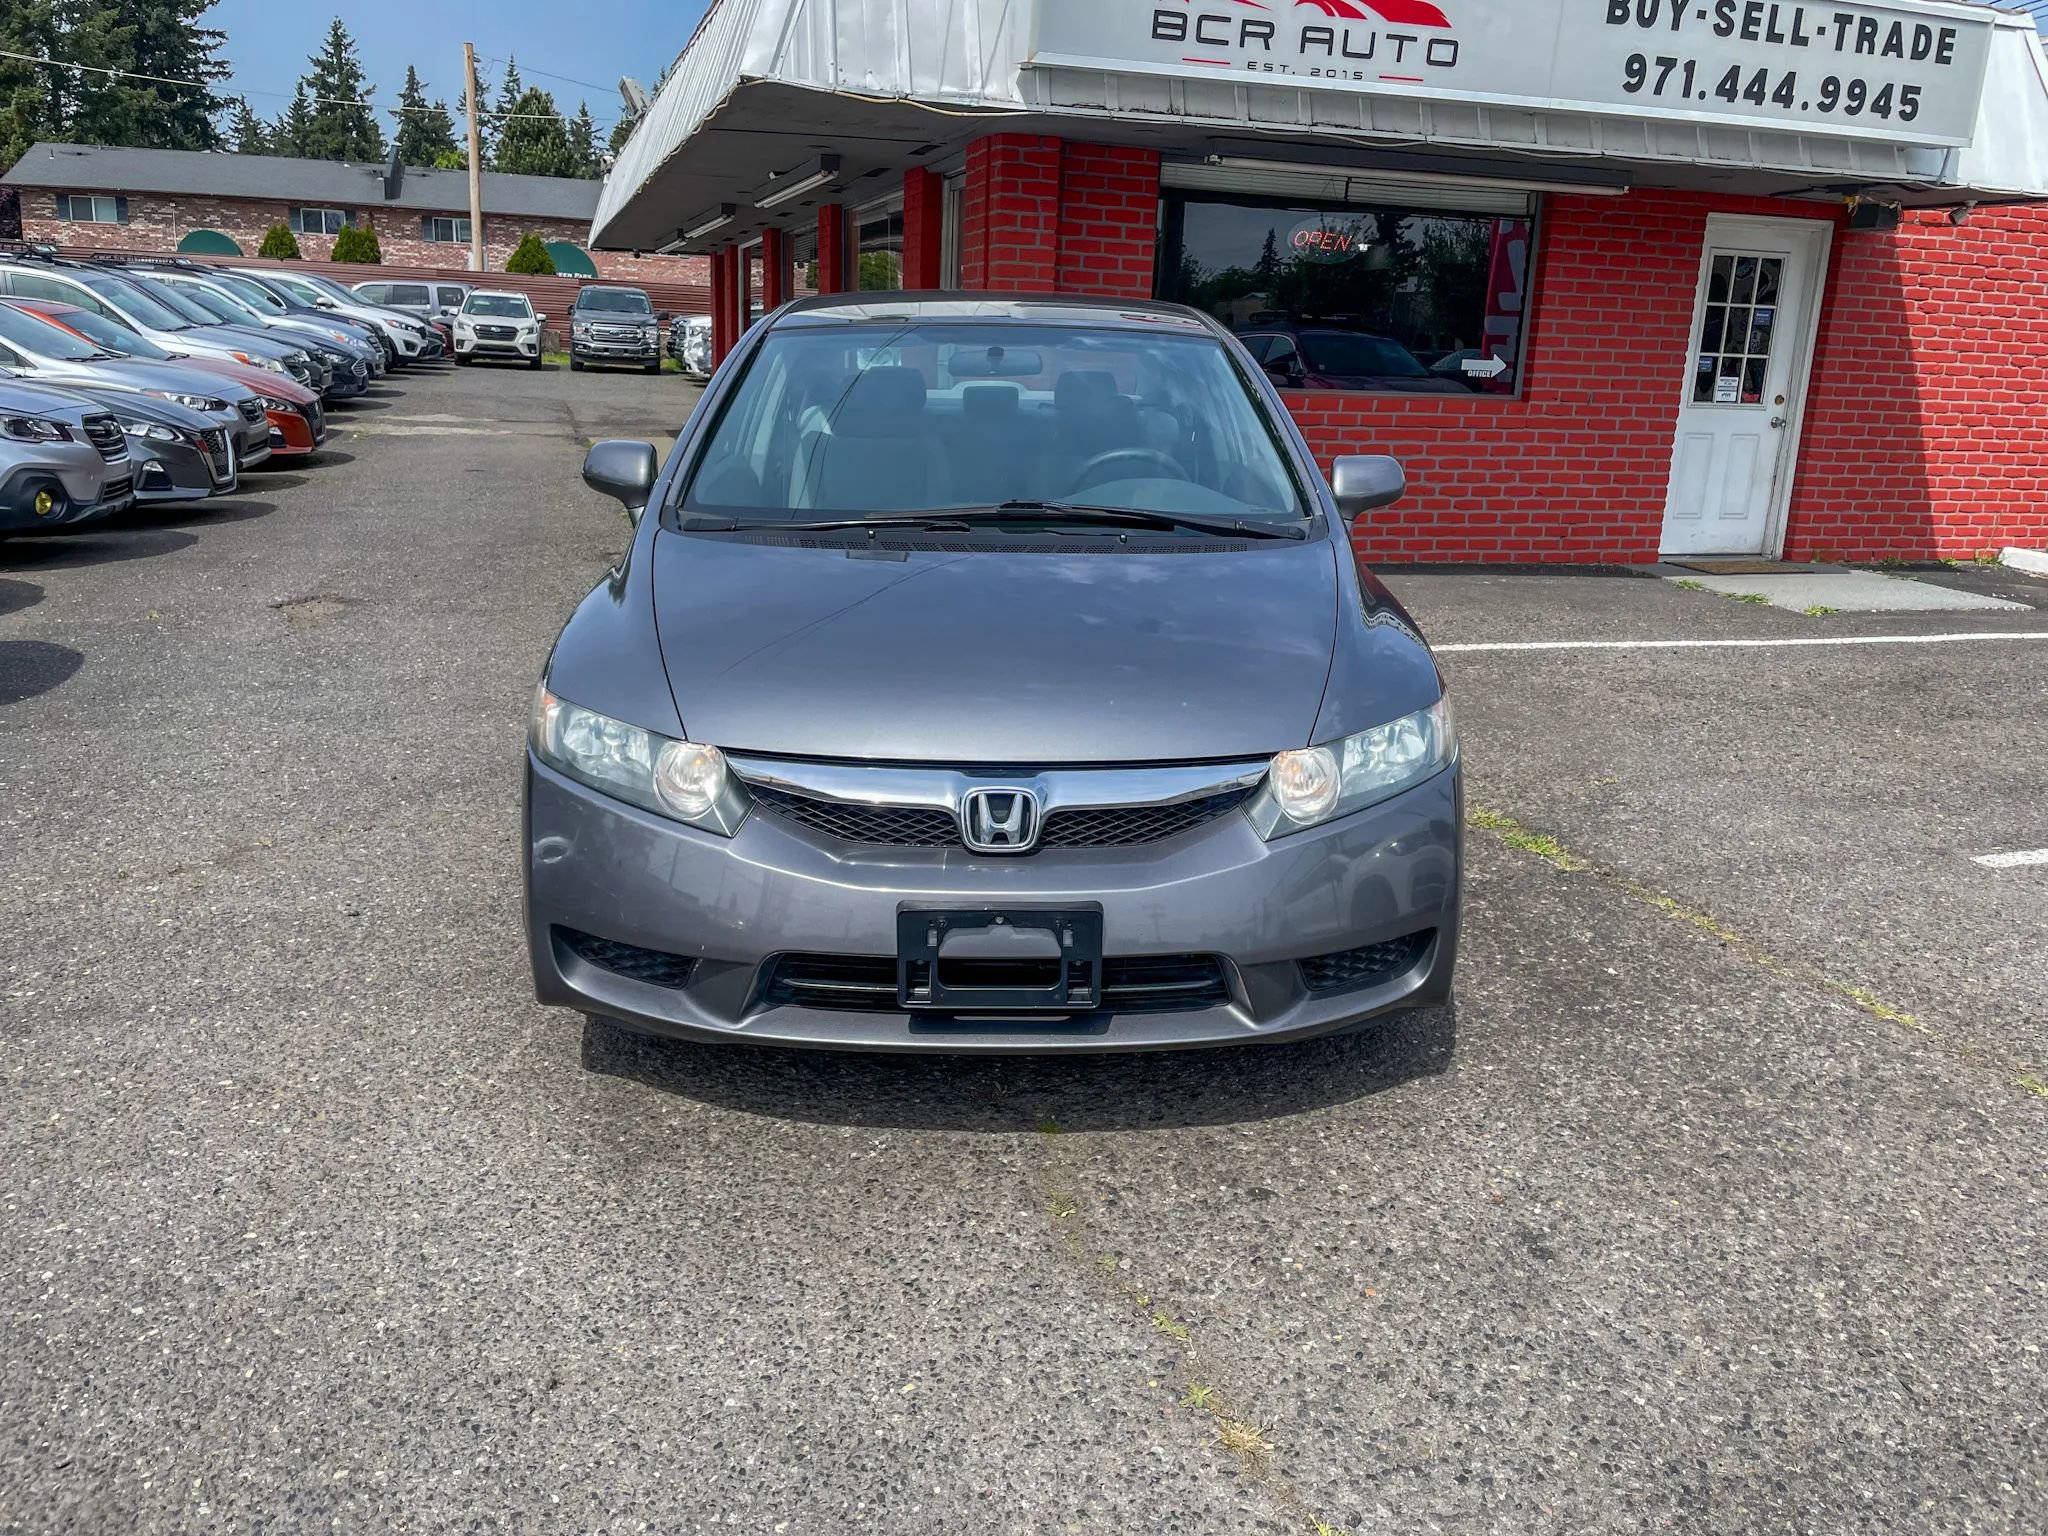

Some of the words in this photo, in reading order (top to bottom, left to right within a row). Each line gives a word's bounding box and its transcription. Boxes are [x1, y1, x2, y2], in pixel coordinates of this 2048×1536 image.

[1152, 9, 1275, 51] BCR
[1300, 26, 1459, 68] AUTO
[1247, 61, 1296, 75] EST.
[1310, 67, 1364, 80] 2015
[1622, 53, 1923, 122] 971.444.9945
[1294, 230, 1353, 252] OPEN
[1467, 370, 1491, 378] OFFICE
